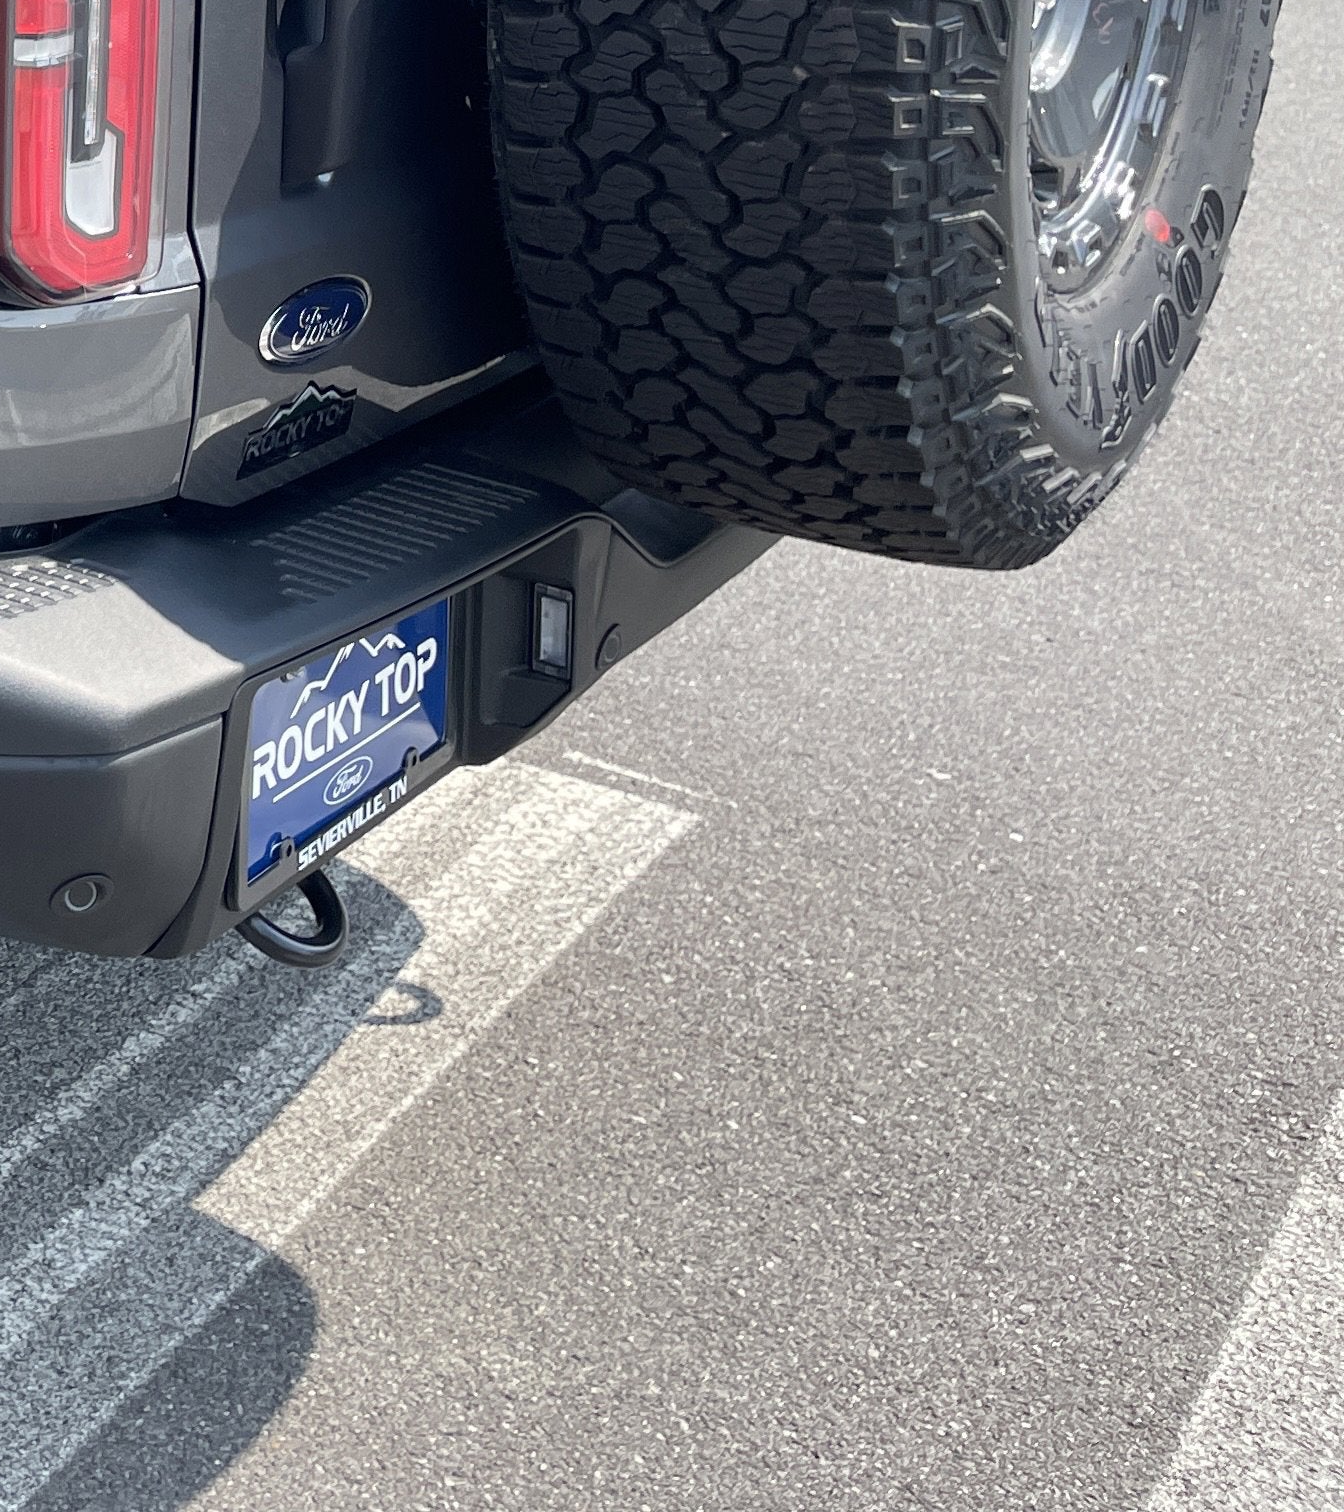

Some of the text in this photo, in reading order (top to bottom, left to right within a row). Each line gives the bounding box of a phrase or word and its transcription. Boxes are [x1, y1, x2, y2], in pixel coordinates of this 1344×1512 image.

[291, 303, 350, 352] Ford
[245, 413, 313, 462] ROCKY
[252, 636, 438, 800] ROCKY TOP
[331, 763, 365, 800] Ford
[297, 775, 408, 872] SEVIERVILLE, TN
